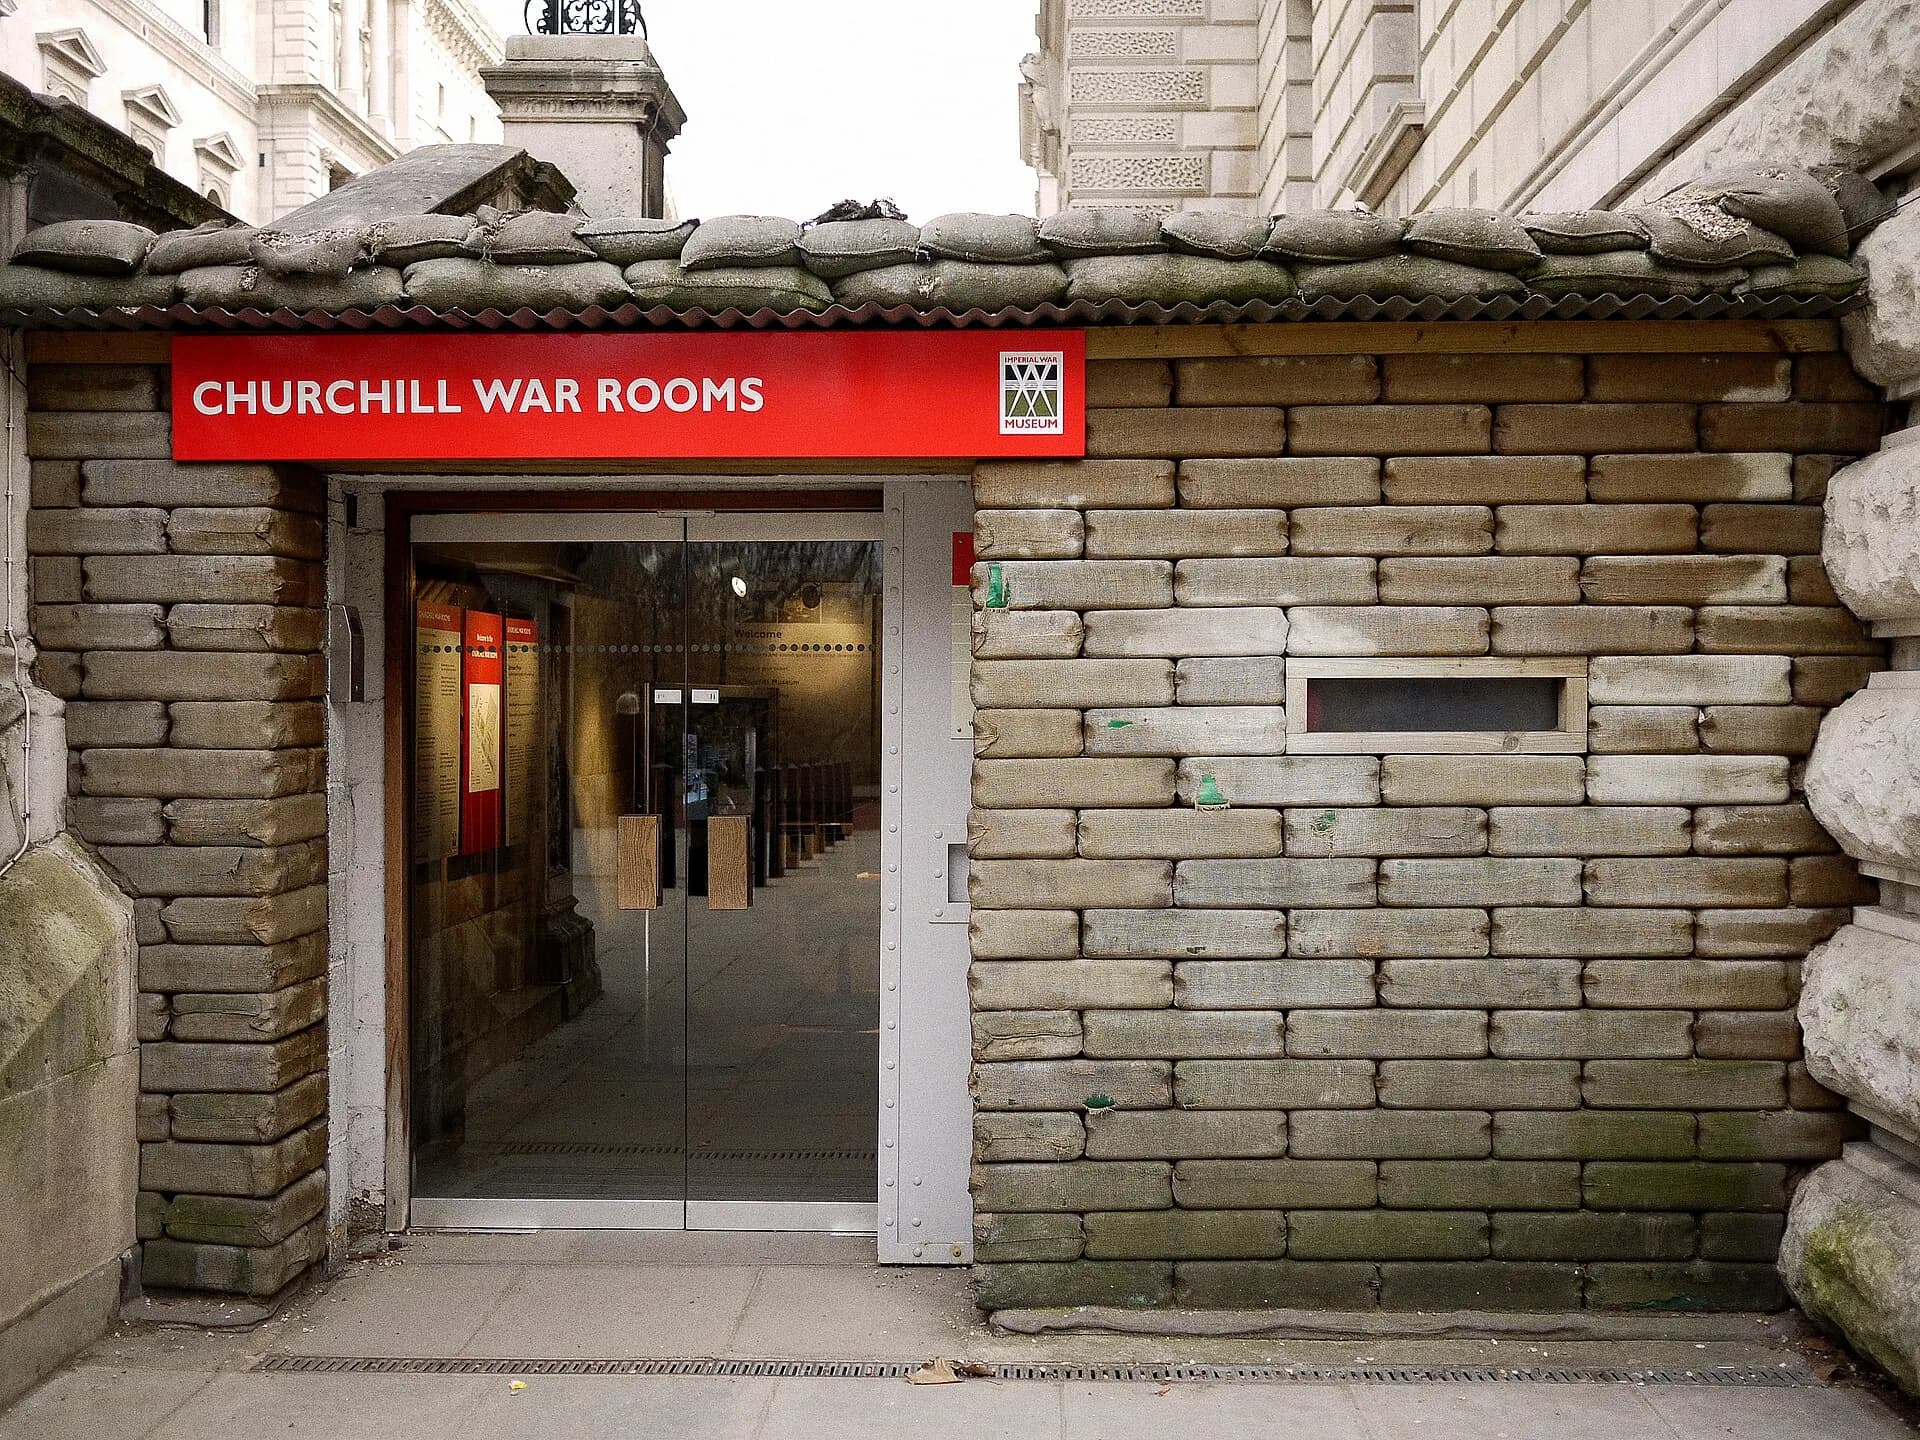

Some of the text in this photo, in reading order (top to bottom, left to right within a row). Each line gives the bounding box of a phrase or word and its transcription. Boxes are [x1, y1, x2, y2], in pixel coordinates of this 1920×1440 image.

[192, 376, 765, 416] CHURCHILL WAR ROOMS
[1005, 419, 1058, 428] MUSEUM
[734, 629, 783, 639] Welcome
